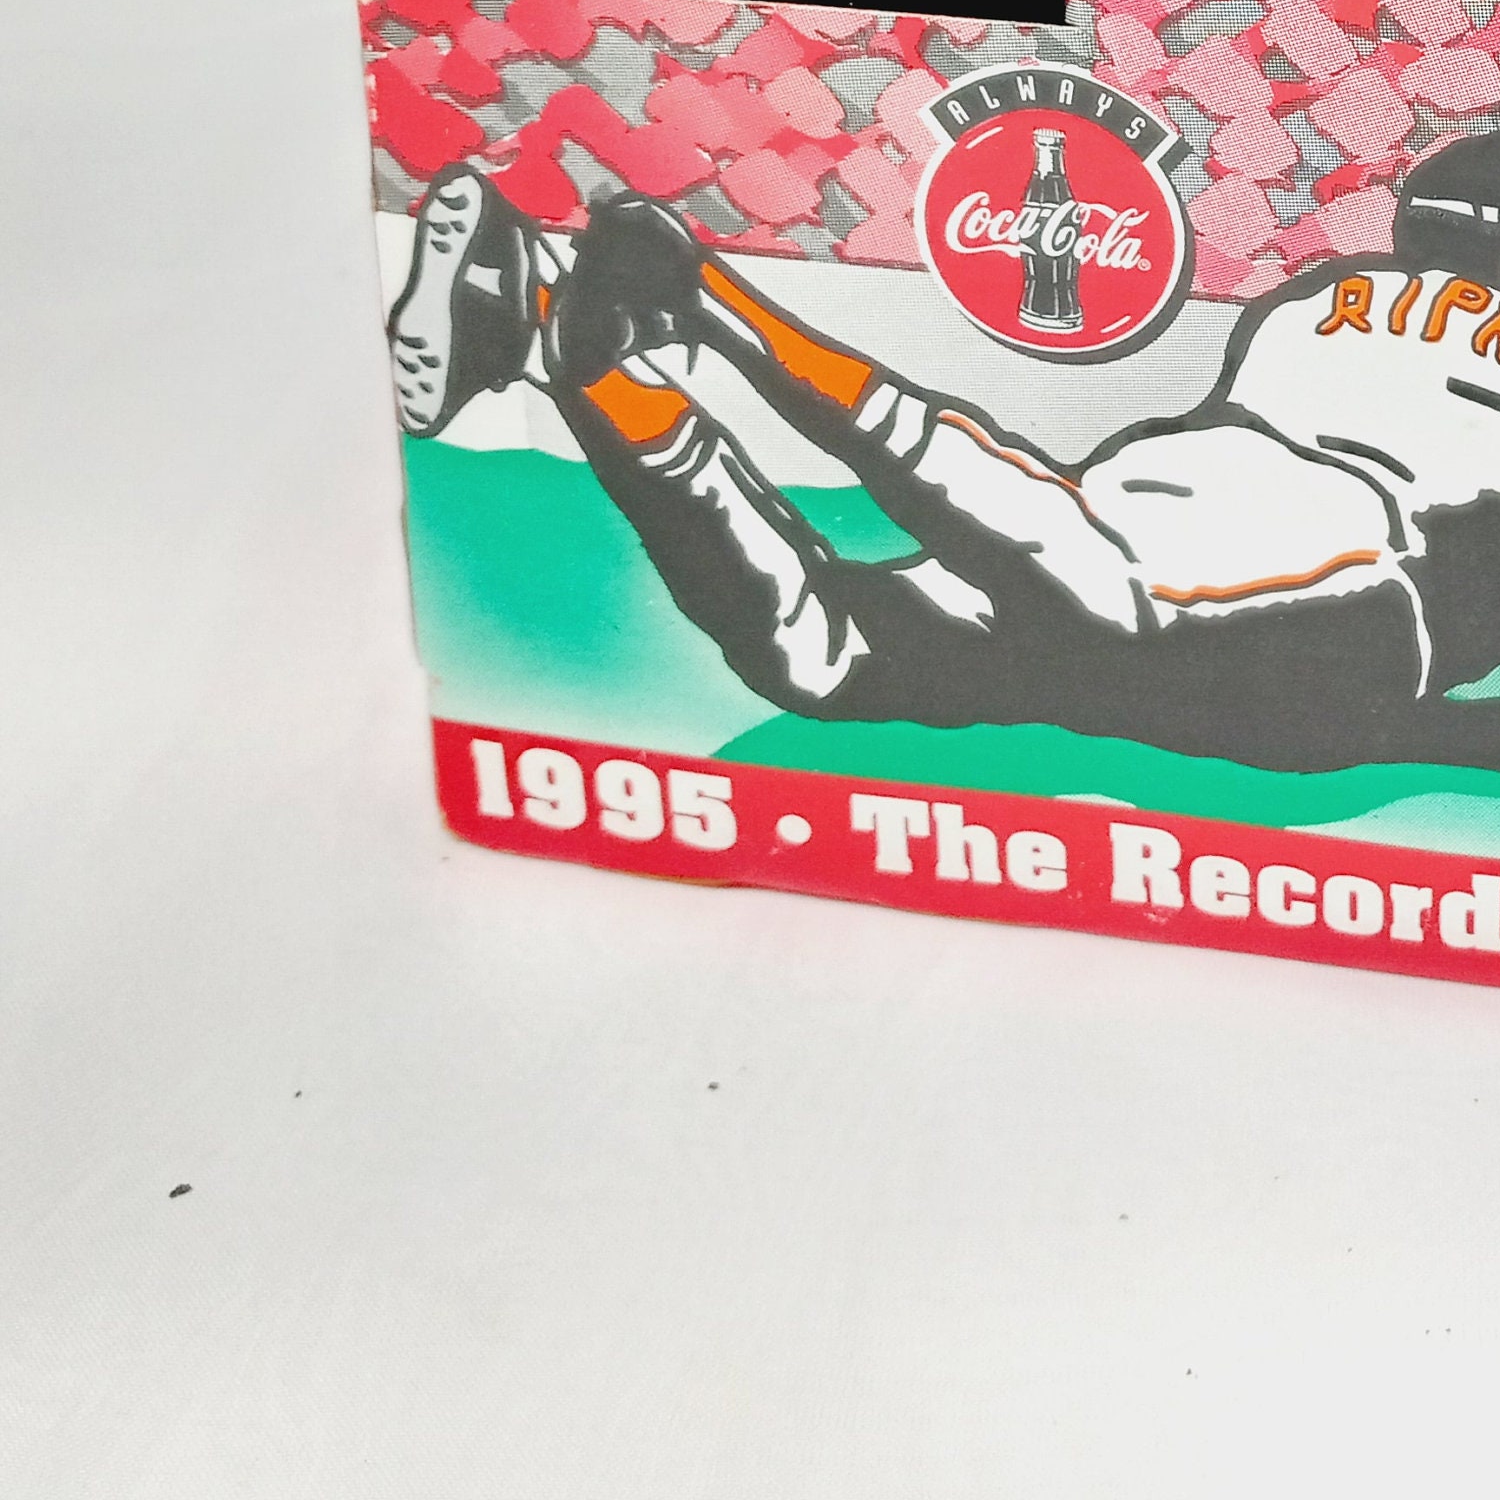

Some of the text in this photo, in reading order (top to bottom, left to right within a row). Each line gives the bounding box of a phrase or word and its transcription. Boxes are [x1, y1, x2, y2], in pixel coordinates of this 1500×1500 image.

[946, 74, 1147, 140] ALWAYS
[471, 738, 737, 852] 1995
[849, 792, 1069, 892] The
